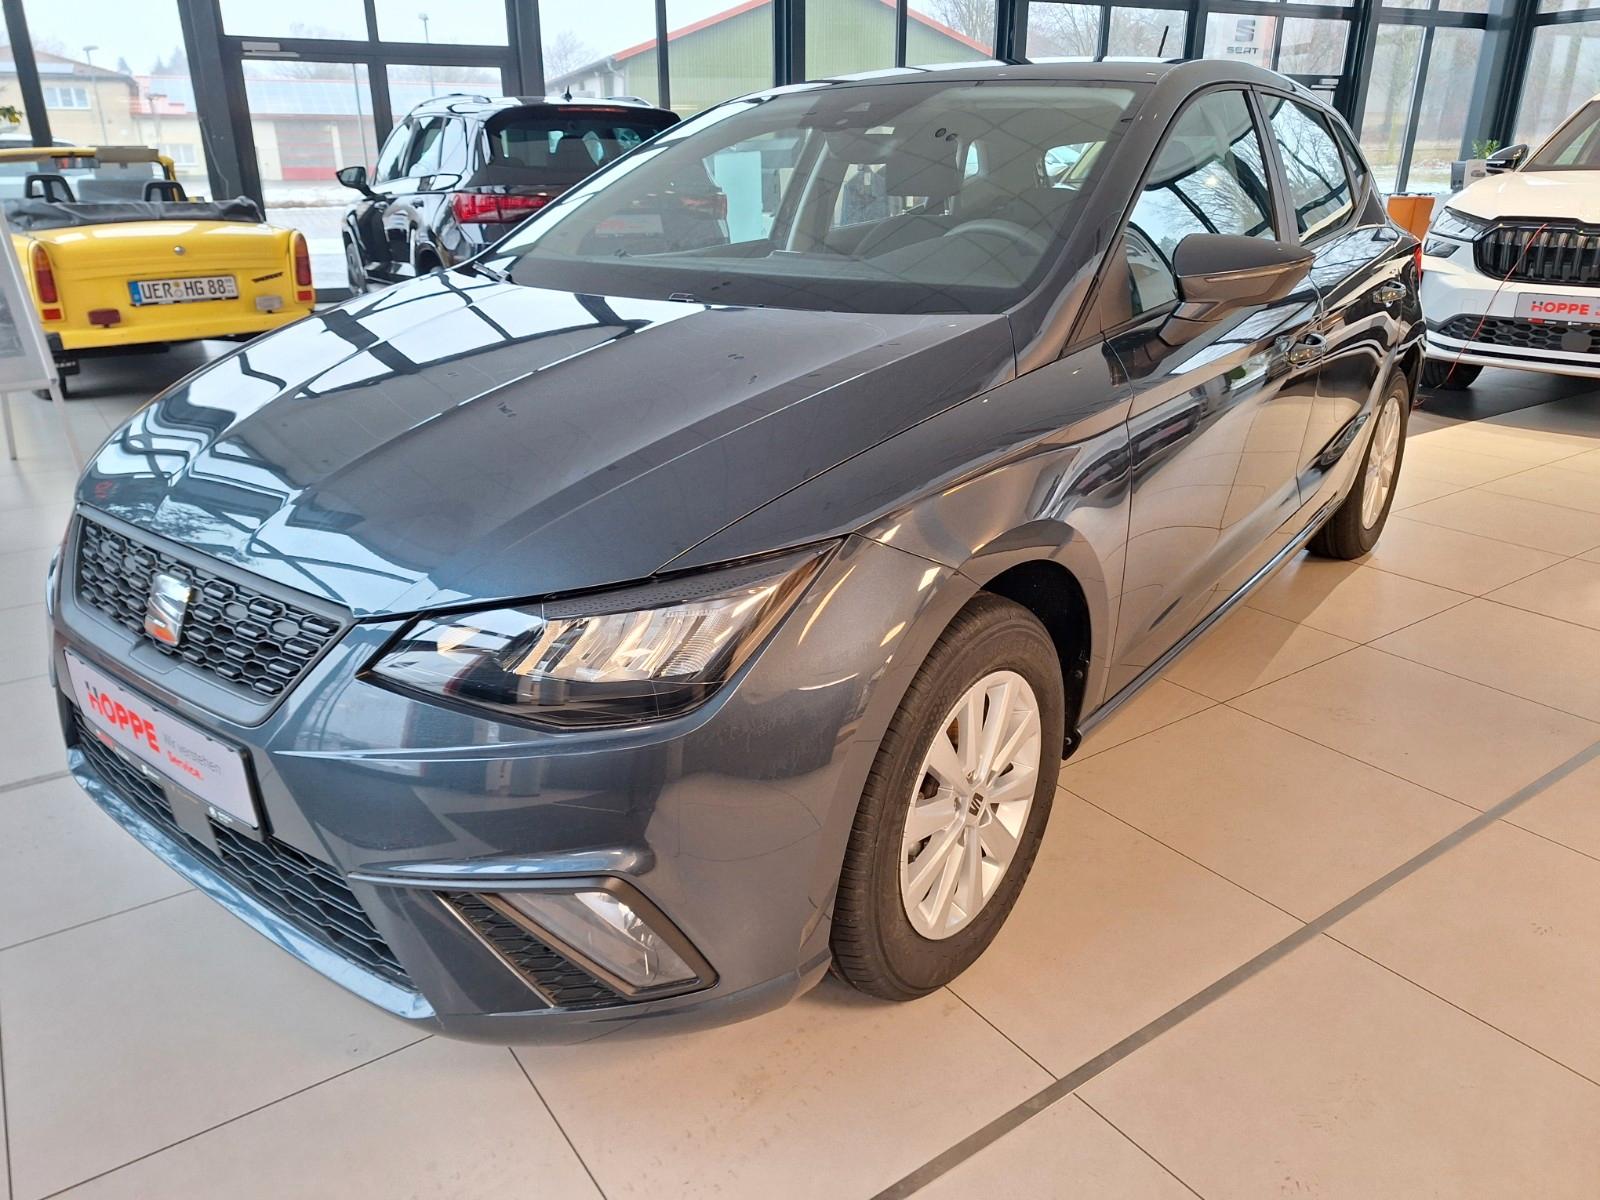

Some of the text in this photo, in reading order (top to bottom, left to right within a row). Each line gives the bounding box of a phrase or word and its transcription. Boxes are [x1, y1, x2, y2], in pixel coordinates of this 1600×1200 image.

[1226, 46, 1259, 55] SEAT
[140, 282, 174, 300] UER
[183, 280, 205, 297] HG
[207, 279, 227, 295] 88
[1530, 300, 1590, 316] HOPPE
[84, 680, 161, 753] HOPPE
